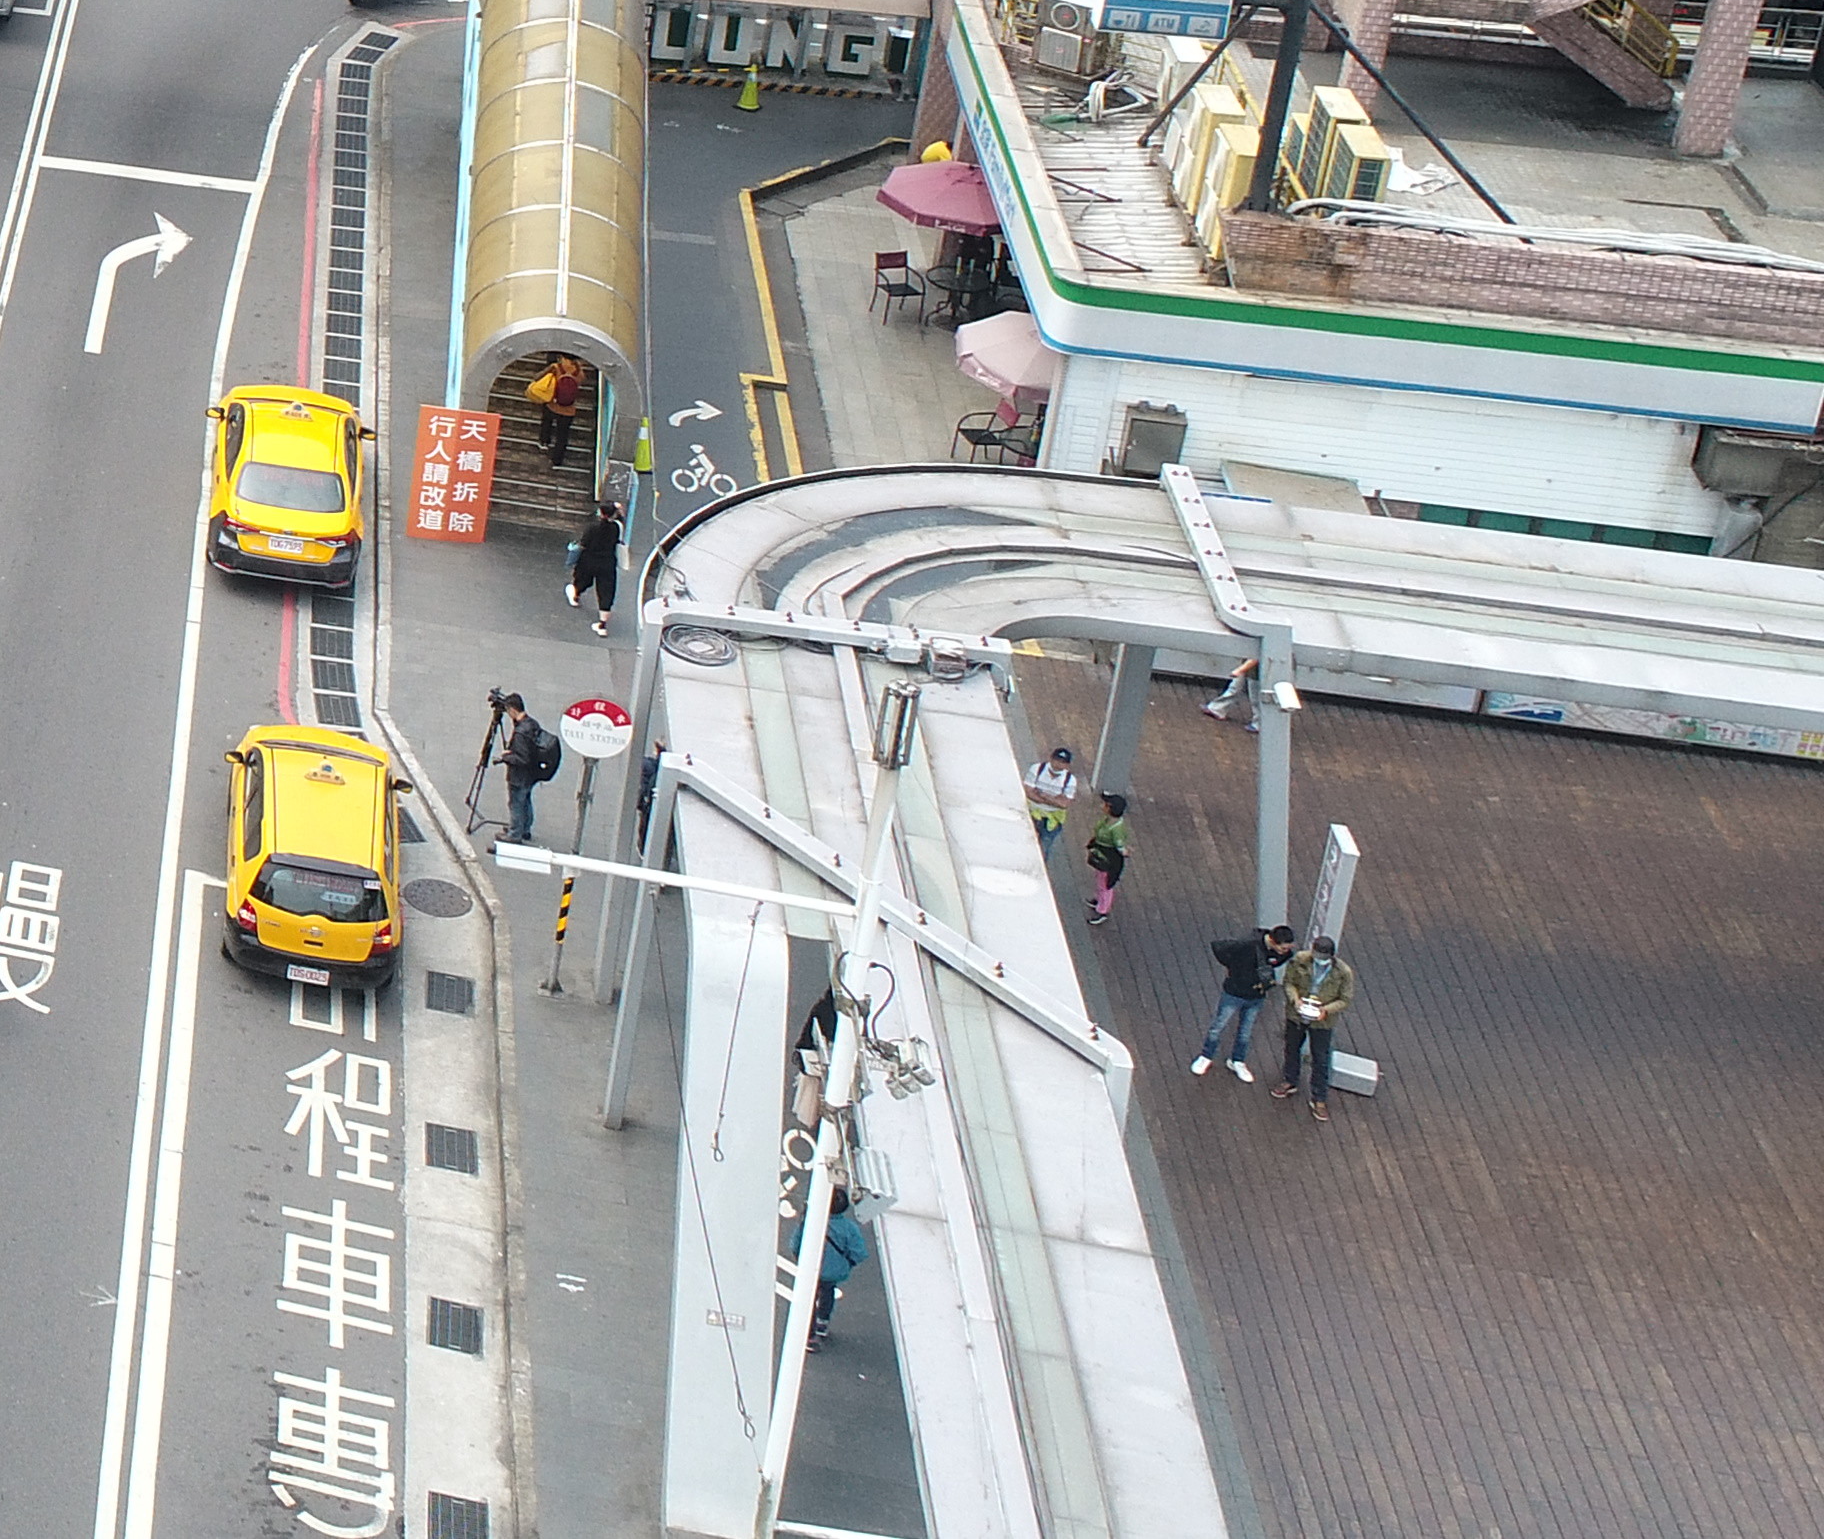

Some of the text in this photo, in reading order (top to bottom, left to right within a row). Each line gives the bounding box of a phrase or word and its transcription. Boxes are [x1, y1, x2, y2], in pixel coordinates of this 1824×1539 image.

[417, 415, 456, 530] 行人請改道
[448, 419, 487, 532] 天橋拆除
[564, 729, 626, 745] TAXI STATION
